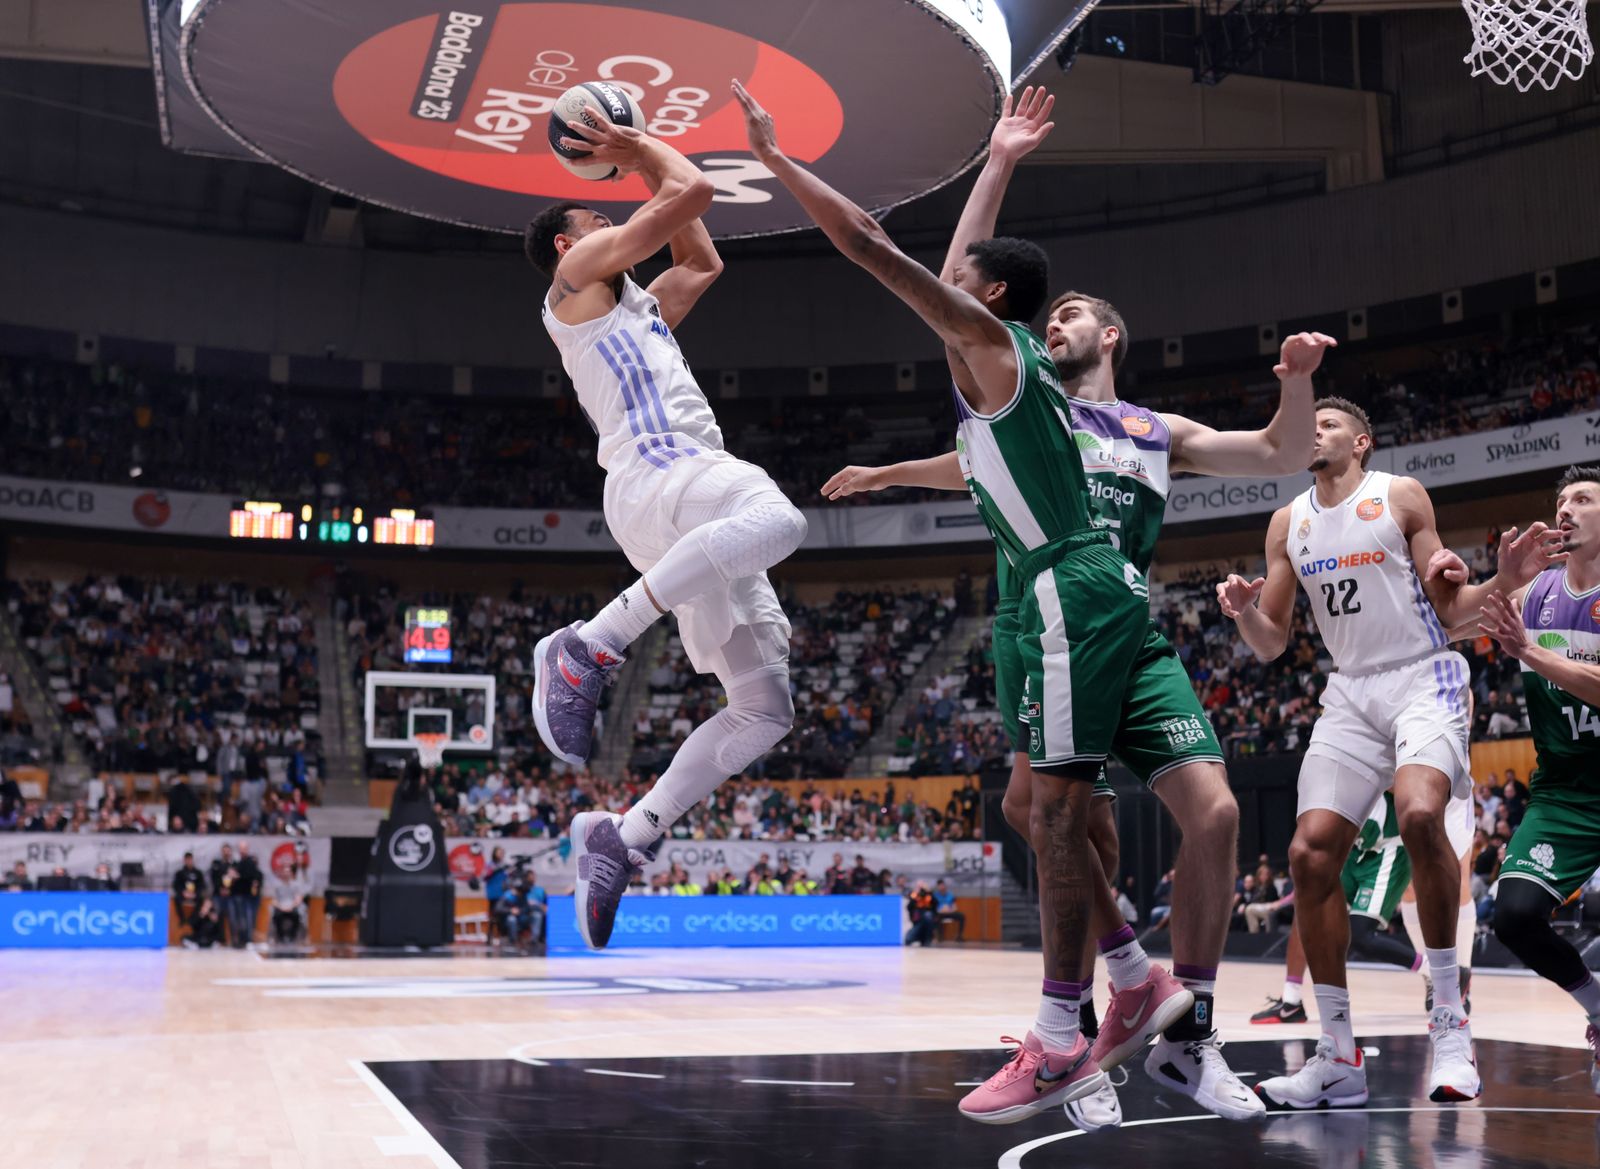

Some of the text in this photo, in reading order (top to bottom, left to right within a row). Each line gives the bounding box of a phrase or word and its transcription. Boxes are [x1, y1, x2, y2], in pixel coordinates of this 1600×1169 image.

[424, 11, 483, 98] Badalona
[526, 50, 579, 91] del
[455, 88, 561, 153] Rey
[647, 86, 711, 137] acb
[1098, 450, 1148, 474] Unicaja
[1406, 452, 1456, 473] divina
[1486, 433, 1560, 464] SPALDING
[1087, 478, 1136, 506] álaga
[1171, 481, 1279, 513] endesa
[494, 524, 548, 545] acb
[1300, 551, 1386, 578] AUTOHERO
[1321, 578, 1362, 617] 22
[1561, 704, 1600, 741] 14
[26, 843, 74, 863] REY
[668, 848, 727, 866] COPA
[12, 901, 155, 936] endesa
[683, 910, 778, 935] endesa
[790, 908, 883, 933] endesa
